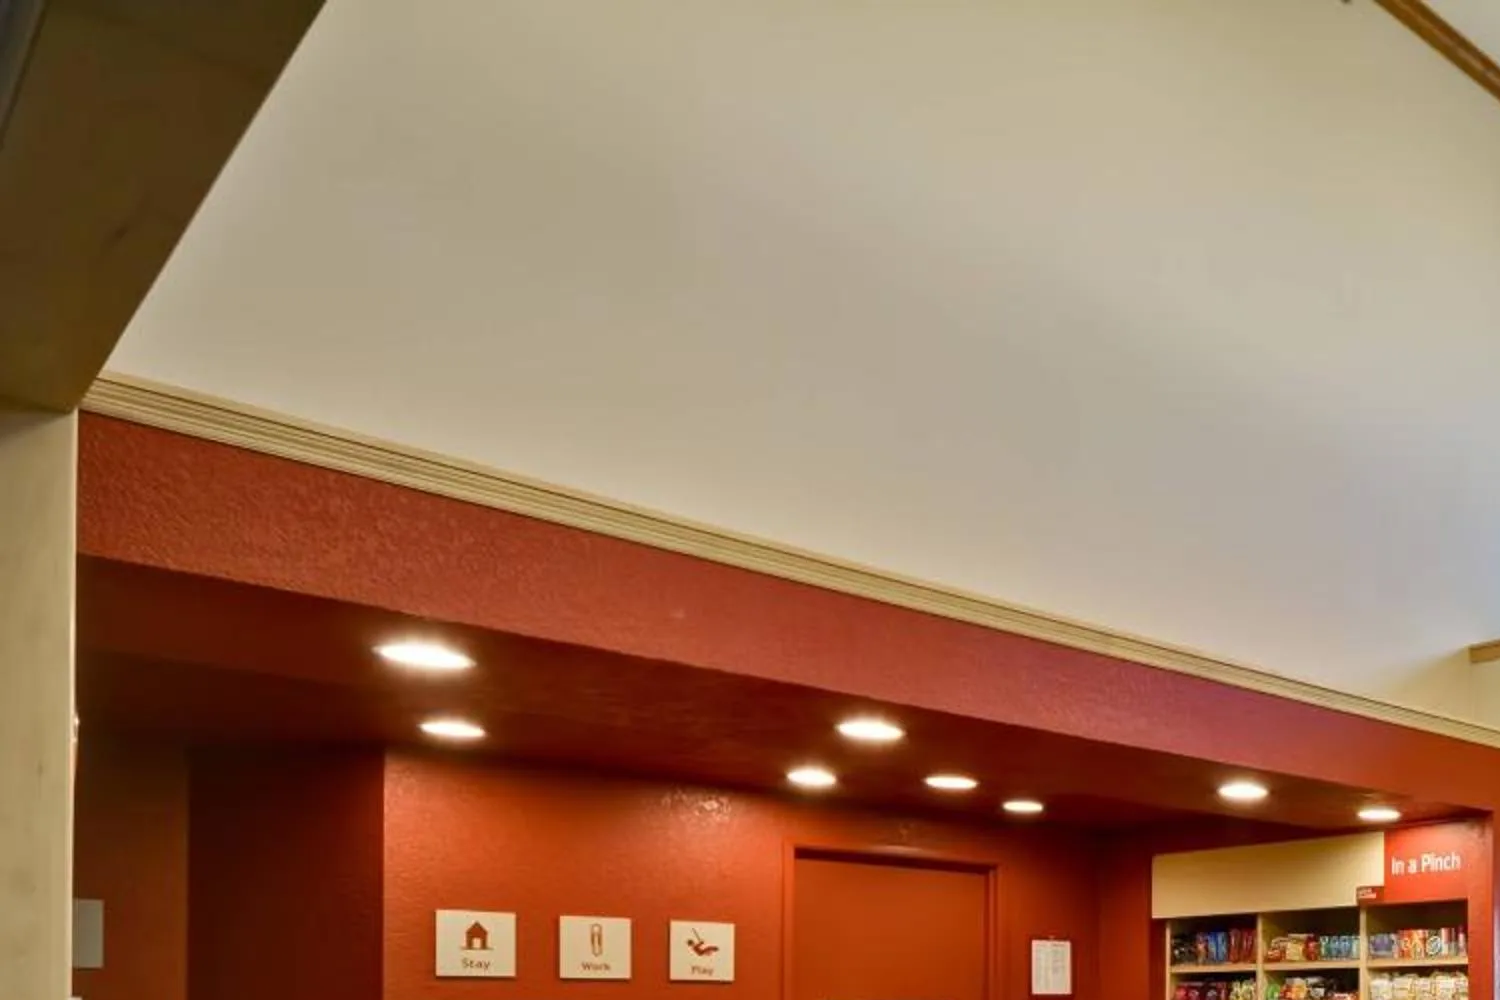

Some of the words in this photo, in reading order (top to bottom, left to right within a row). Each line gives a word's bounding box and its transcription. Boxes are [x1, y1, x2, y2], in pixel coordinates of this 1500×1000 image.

[1390, 856, 1405, 876] In
[1407, 858, 1417, 874] a
[1420, 851, 1461, 873] Pinch
[461, 957, 491, 970] Stay
[582, 962, 611, 972] Work
[691, 965, 714, 976] Play
